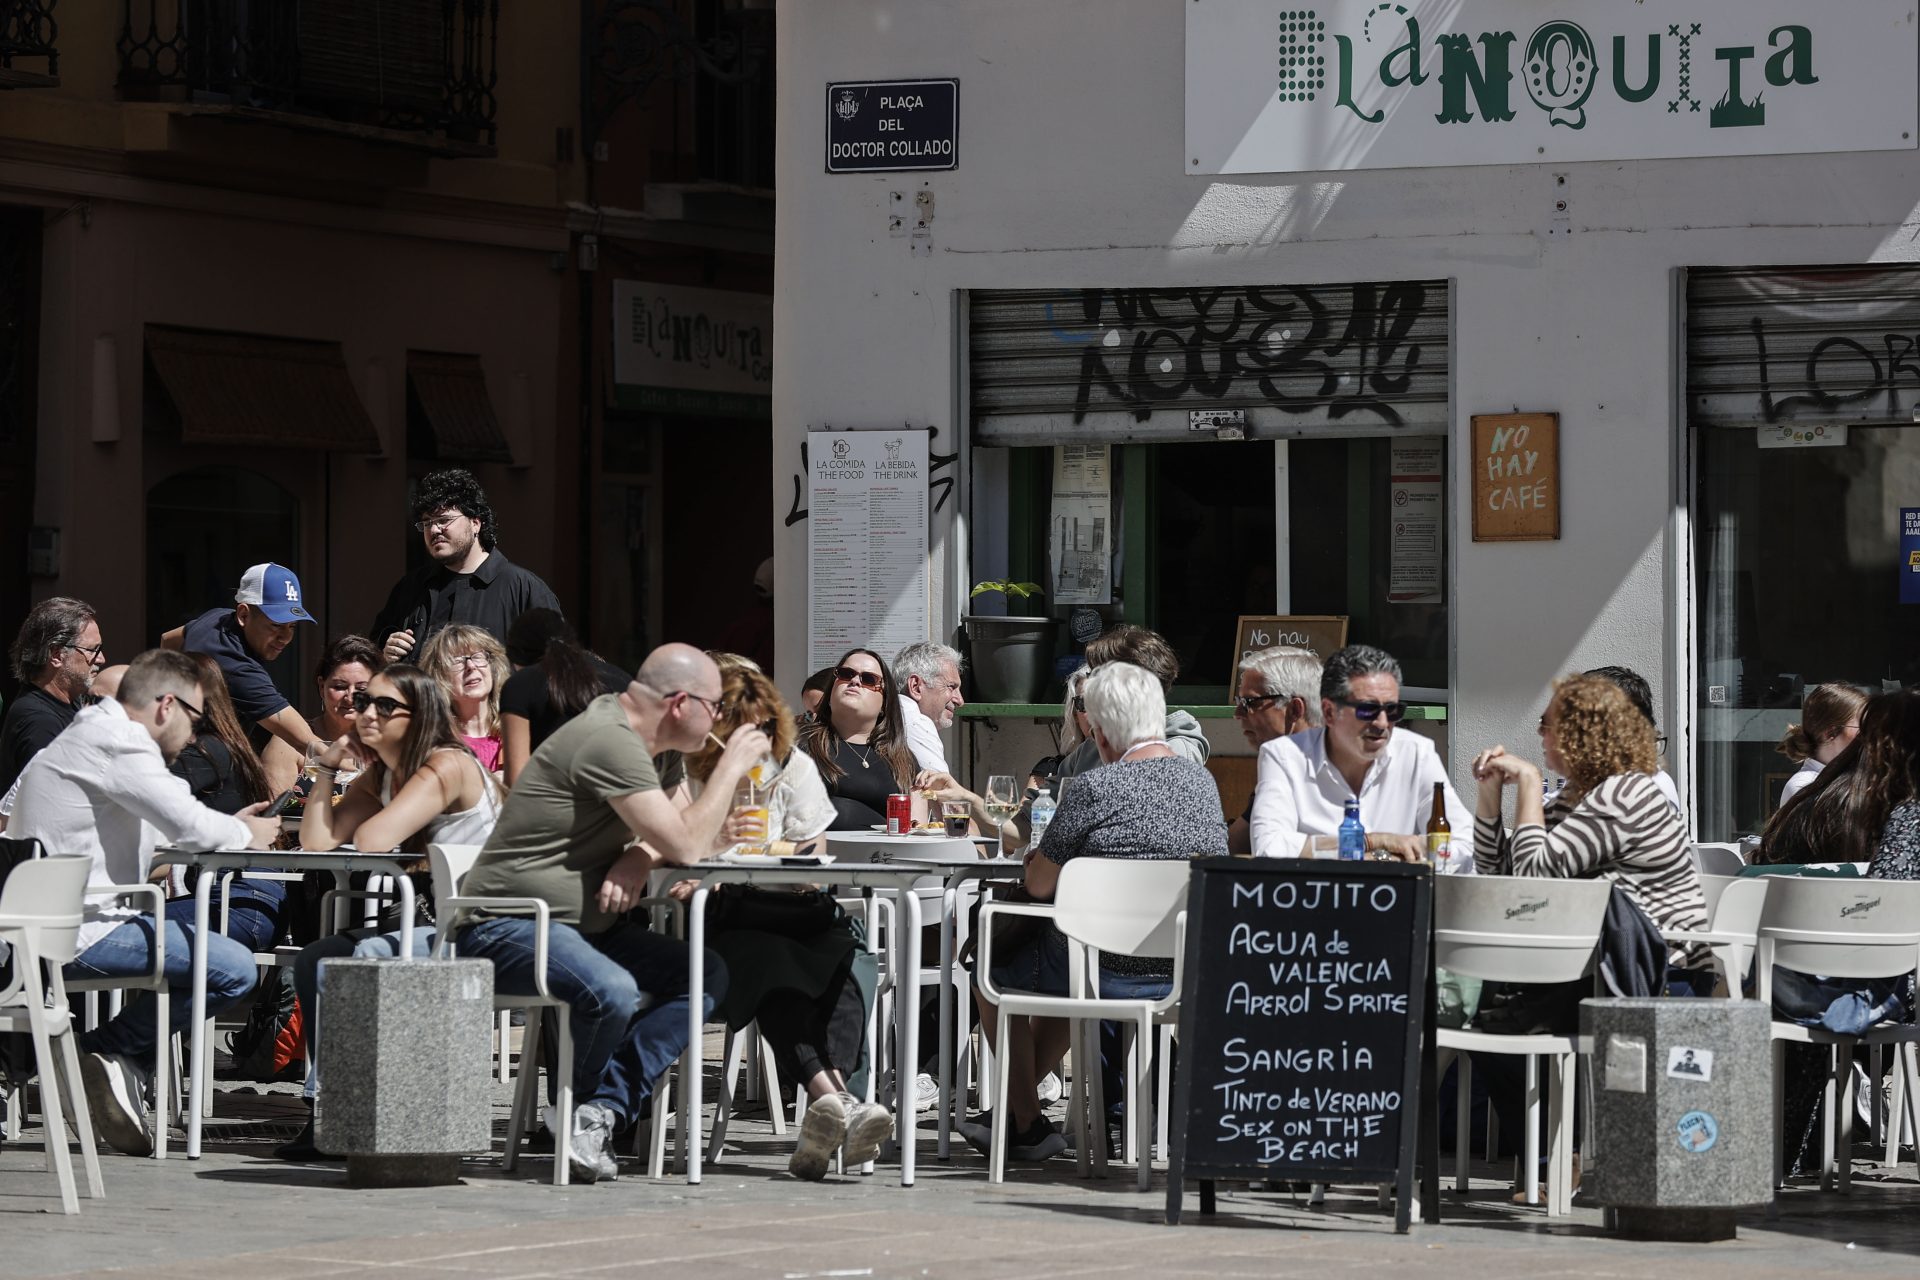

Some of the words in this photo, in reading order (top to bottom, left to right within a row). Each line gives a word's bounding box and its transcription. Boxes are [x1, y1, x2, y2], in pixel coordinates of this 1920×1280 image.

[880, 96, 924, 112] PLAÇA
[878, 119, 904, 131] DEL
[832, 141, 885, 158] DOCTOR
[889, 139, 952, 156] COLLADO
[1490, 425, 1530, 454] NO
[816, 460, 828, 469] LA
[829, 459, 866, 469] COMIDA
[875, 461, 886, 469] LA
[887, 460, 916, 469] BEBIDA
[1487, 450, 1538, 481] HAY
[818, 471, 838, 479] THE
[838, 471, 864, 479] FOOD
[893, 471, 918, 479] DRINK
[1488, 476, 1549, 511] CAFÉ
[1905, 512, 1916, 520] RED
[284, 580, 298, 601] LA
[1250, 629, 1270, 646] No
[1278, 629, 1309, 649] hay
[1232, 882, 1398, 912] MOJITO
[1229, 922, 1318, 957] AGUA
[1325, 930, 1350, 956] de
[1269, 958, 1392, 985] VALENCIA
[1213, 1078, 1282, 1112] TINTO
[1288, 1086, 1312, 1110] de
[1314, 1087, 1402, 1113] VERANO
[1216, 1114, 1274, 1142] SEX
[1283, 1118, 1312, 1137] ON
[1315, 1114, 1385, 1138] THE
[1256, 1136, 1359, 1164] BEACH
